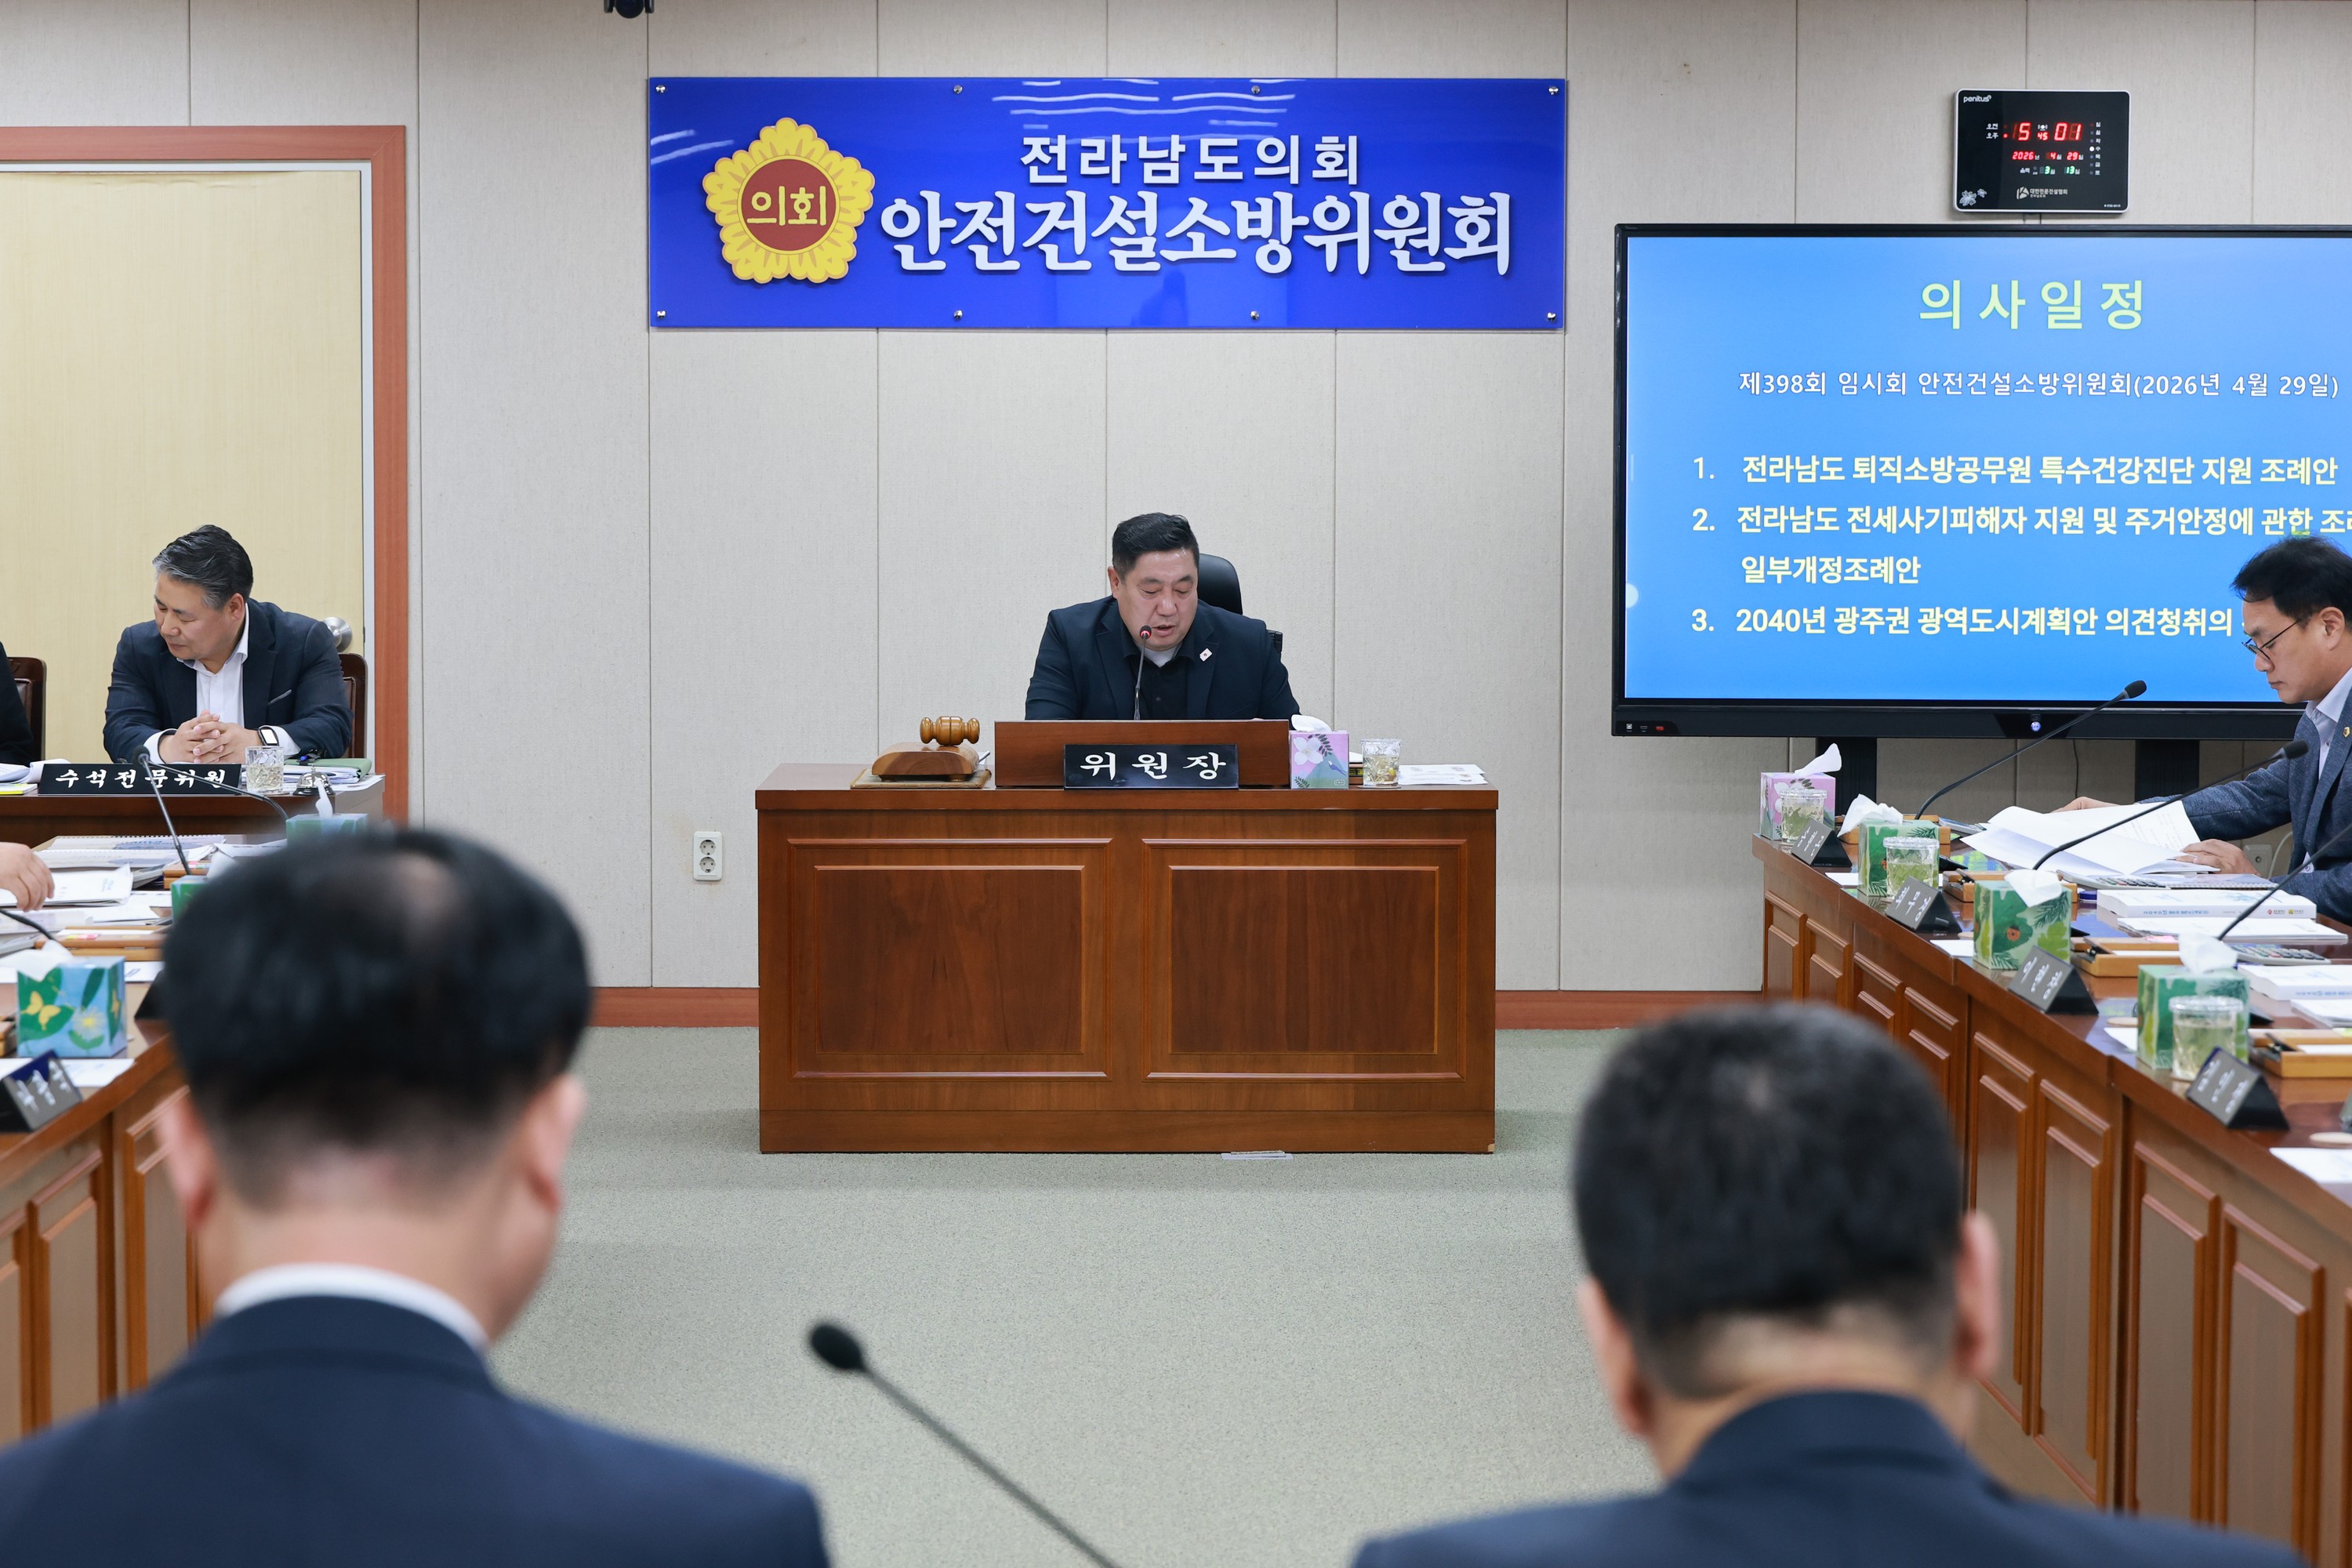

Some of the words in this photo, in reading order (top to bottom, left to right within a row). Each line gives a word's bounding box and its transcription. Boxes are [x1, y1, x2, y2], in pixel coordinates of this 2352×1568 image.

[1021, 134, 1360, 186] 전라남도의회
[746, 187, 829, 227] 의회
[880, 189, 1512, 276] 안전건설소방위원회
[1920, 280, 2143, 330] 의사일정
[1739, 371, 1827, 396] 제398회
[1838, 372, 1907, 396] 임시회
[1918, 372, 2220, 398] 안전건설소방위원회(2026년
[2231, 373, 2268, 397] 4월
[2278, 373, 2339, 399] 29일)
[1693, 456, 1715, 480] 1.
[1743, 455, 1846, 484] 전라남도
[1853, 455, 2031, 485] 퇴직소방공무원
[2039, 456, 2195, 485] 특수건강진단
[2201, 456, 2252, 485] 지원
[2259, 456, 2339, 486] 조례안
[1692, 507, 1715, 532] 2.
[1737, 505, 1840, 535] 전라남도
[1847, 505, 2028, 535] 전세사기피해자
[2034, 506, 2084, 535] 지원
[2093, 506, 2118, 535] 및
[2125, 506, 2253, 535] 주거안정에
[2261, 507, 2314, 536] 관한
[2319, 509, 2352, 533] 조
[1741, 555, 1922, 585] 일부개정조례안
[1691, 608, 1715, 632] 3.
[1736, 605, 1827, 634] 2040년
[1834, 606, 1910, 635] 광주권
[1918, 606, 2099, 636] 광역도시계획안
[2105, 607, 2232, 637] 의견청취의
[55, 768, 227, 789] 수석전문위원
[1080, 751, 1227, 781] 위원장
[1894, 885, 1932, 922] 최무경
